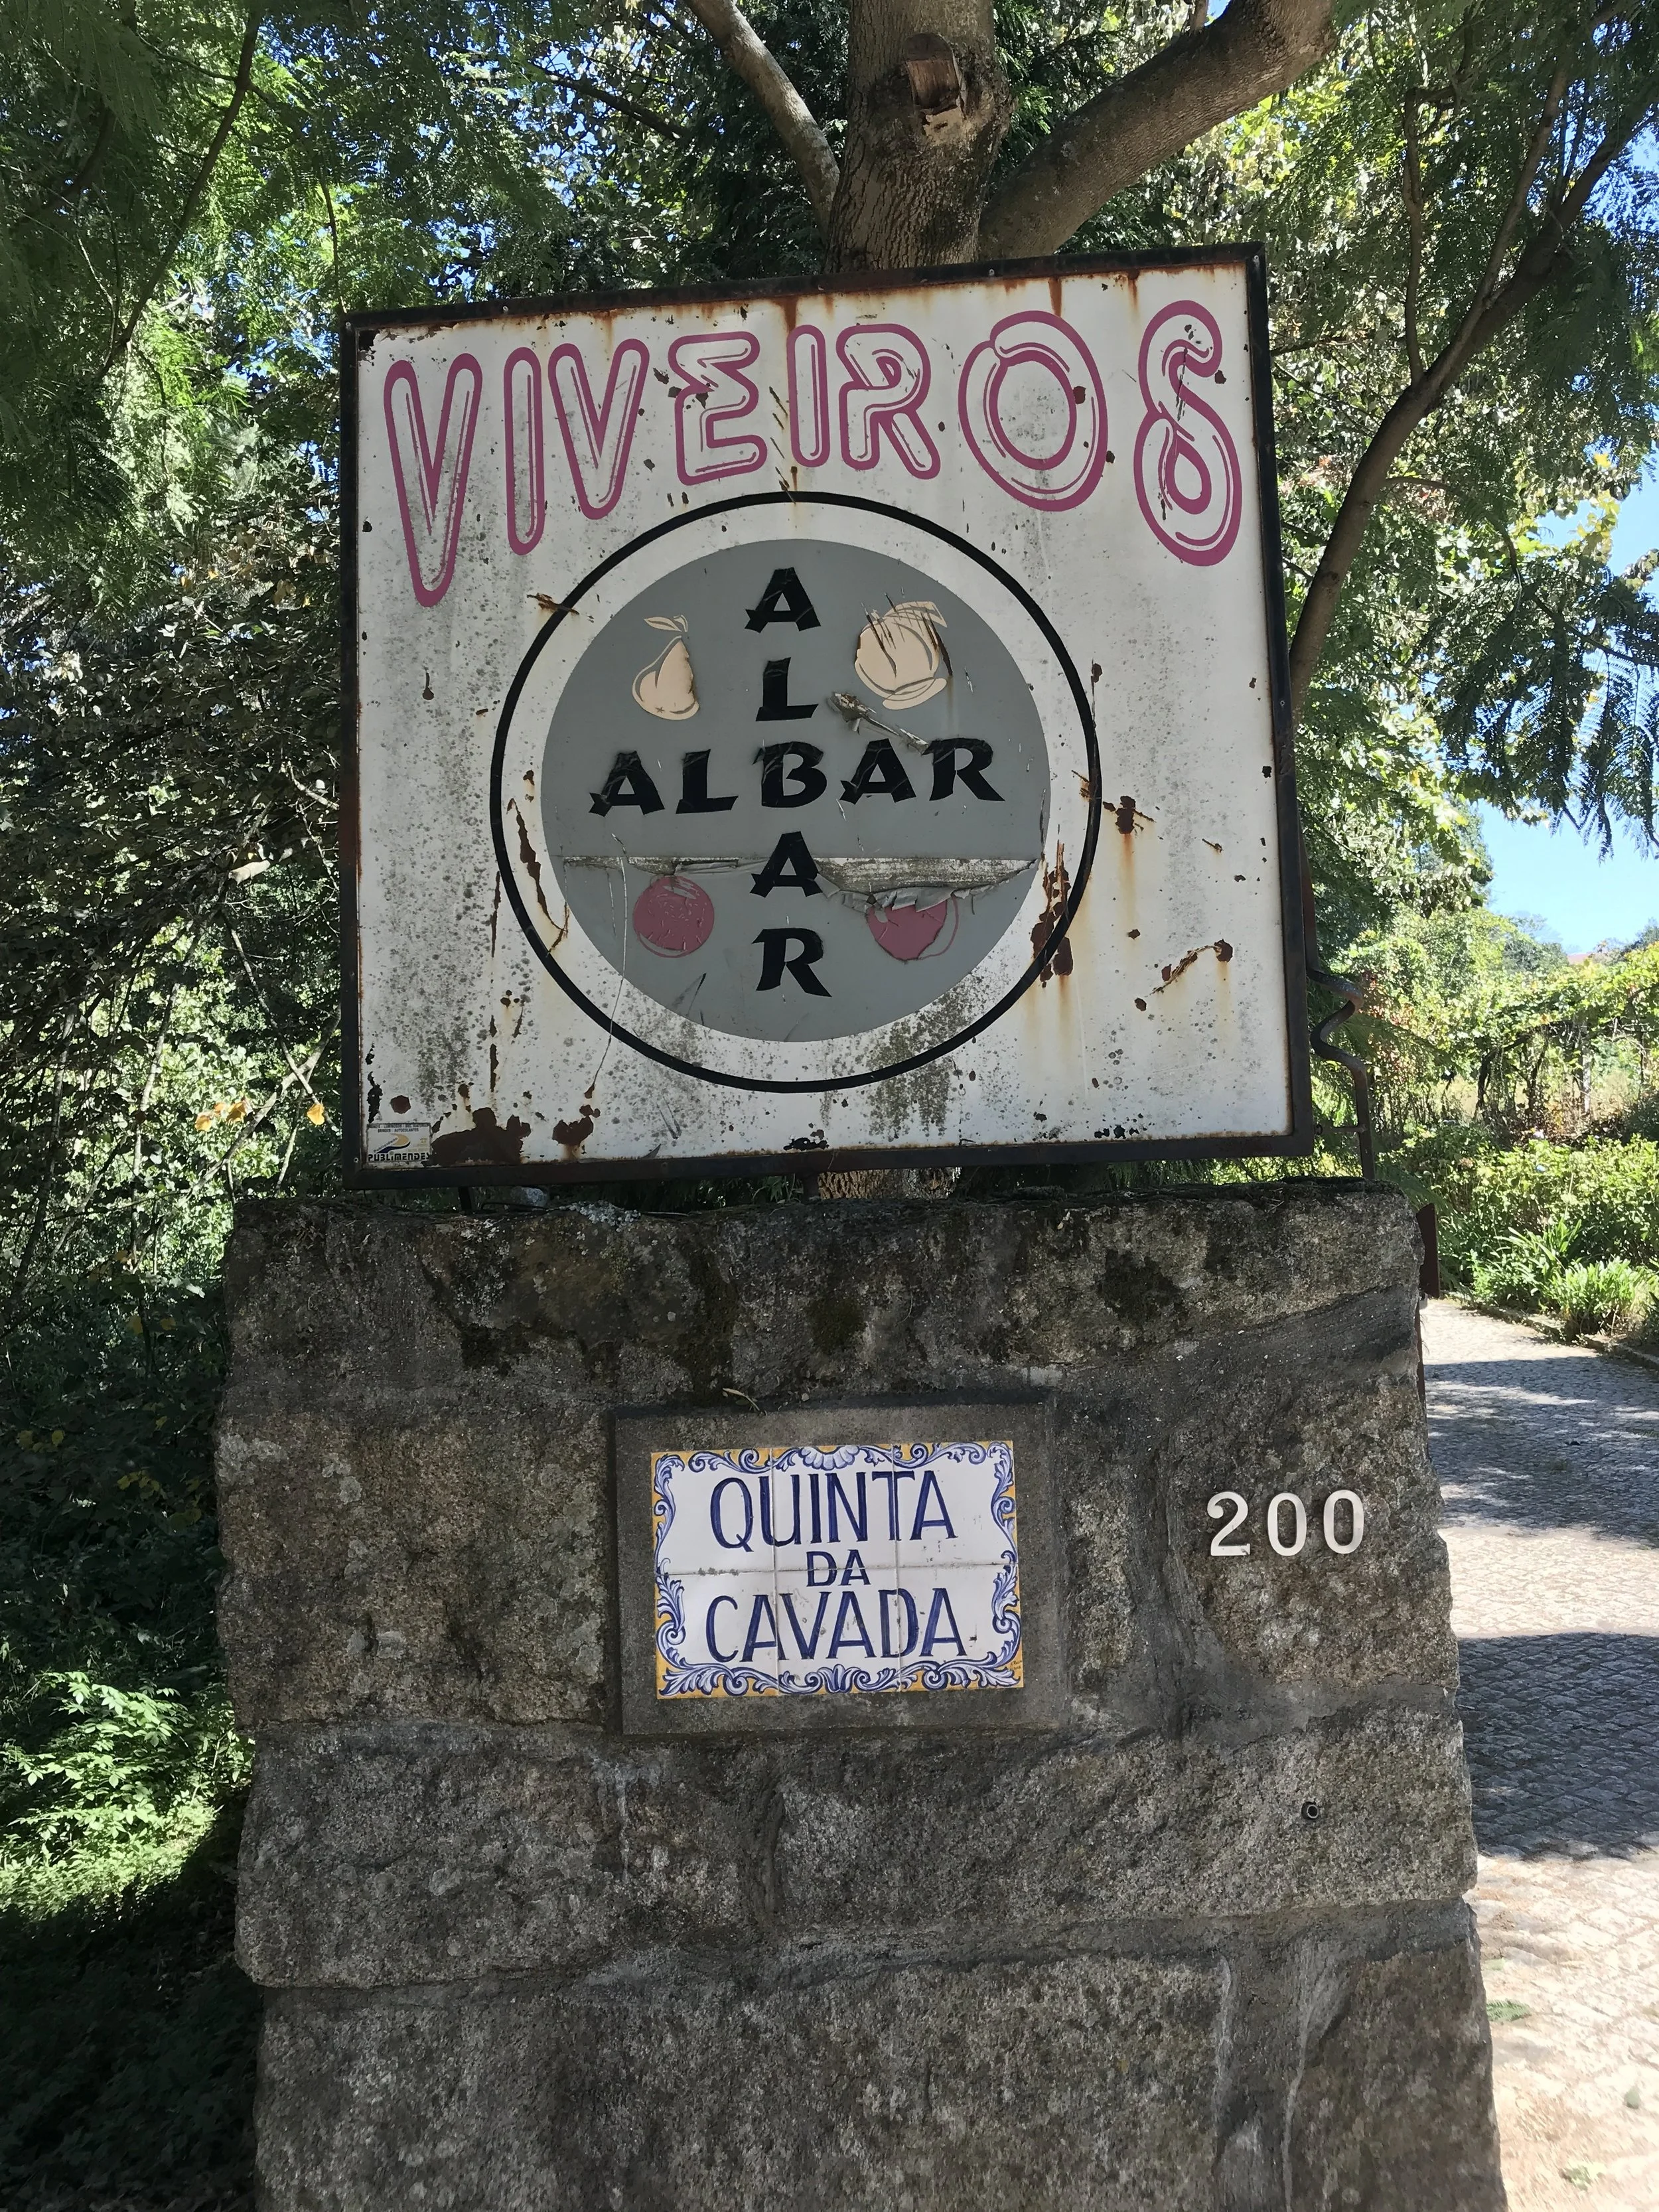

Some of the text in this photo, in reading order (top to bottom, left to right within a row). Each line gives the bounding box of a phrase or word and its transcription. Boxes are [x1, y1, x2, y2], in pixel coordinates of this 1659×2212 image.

[384, 300, 1242, 607] VIVEIROS
[589, 737, 1005, 817] ALBAR
[710, 1470, 958, 1552] QUINTA
[1206, 1489, 1364, 1556] 200
[806, 1549, 871, 1587] DA
[705, 1587, 968, 1662] CAVADA
